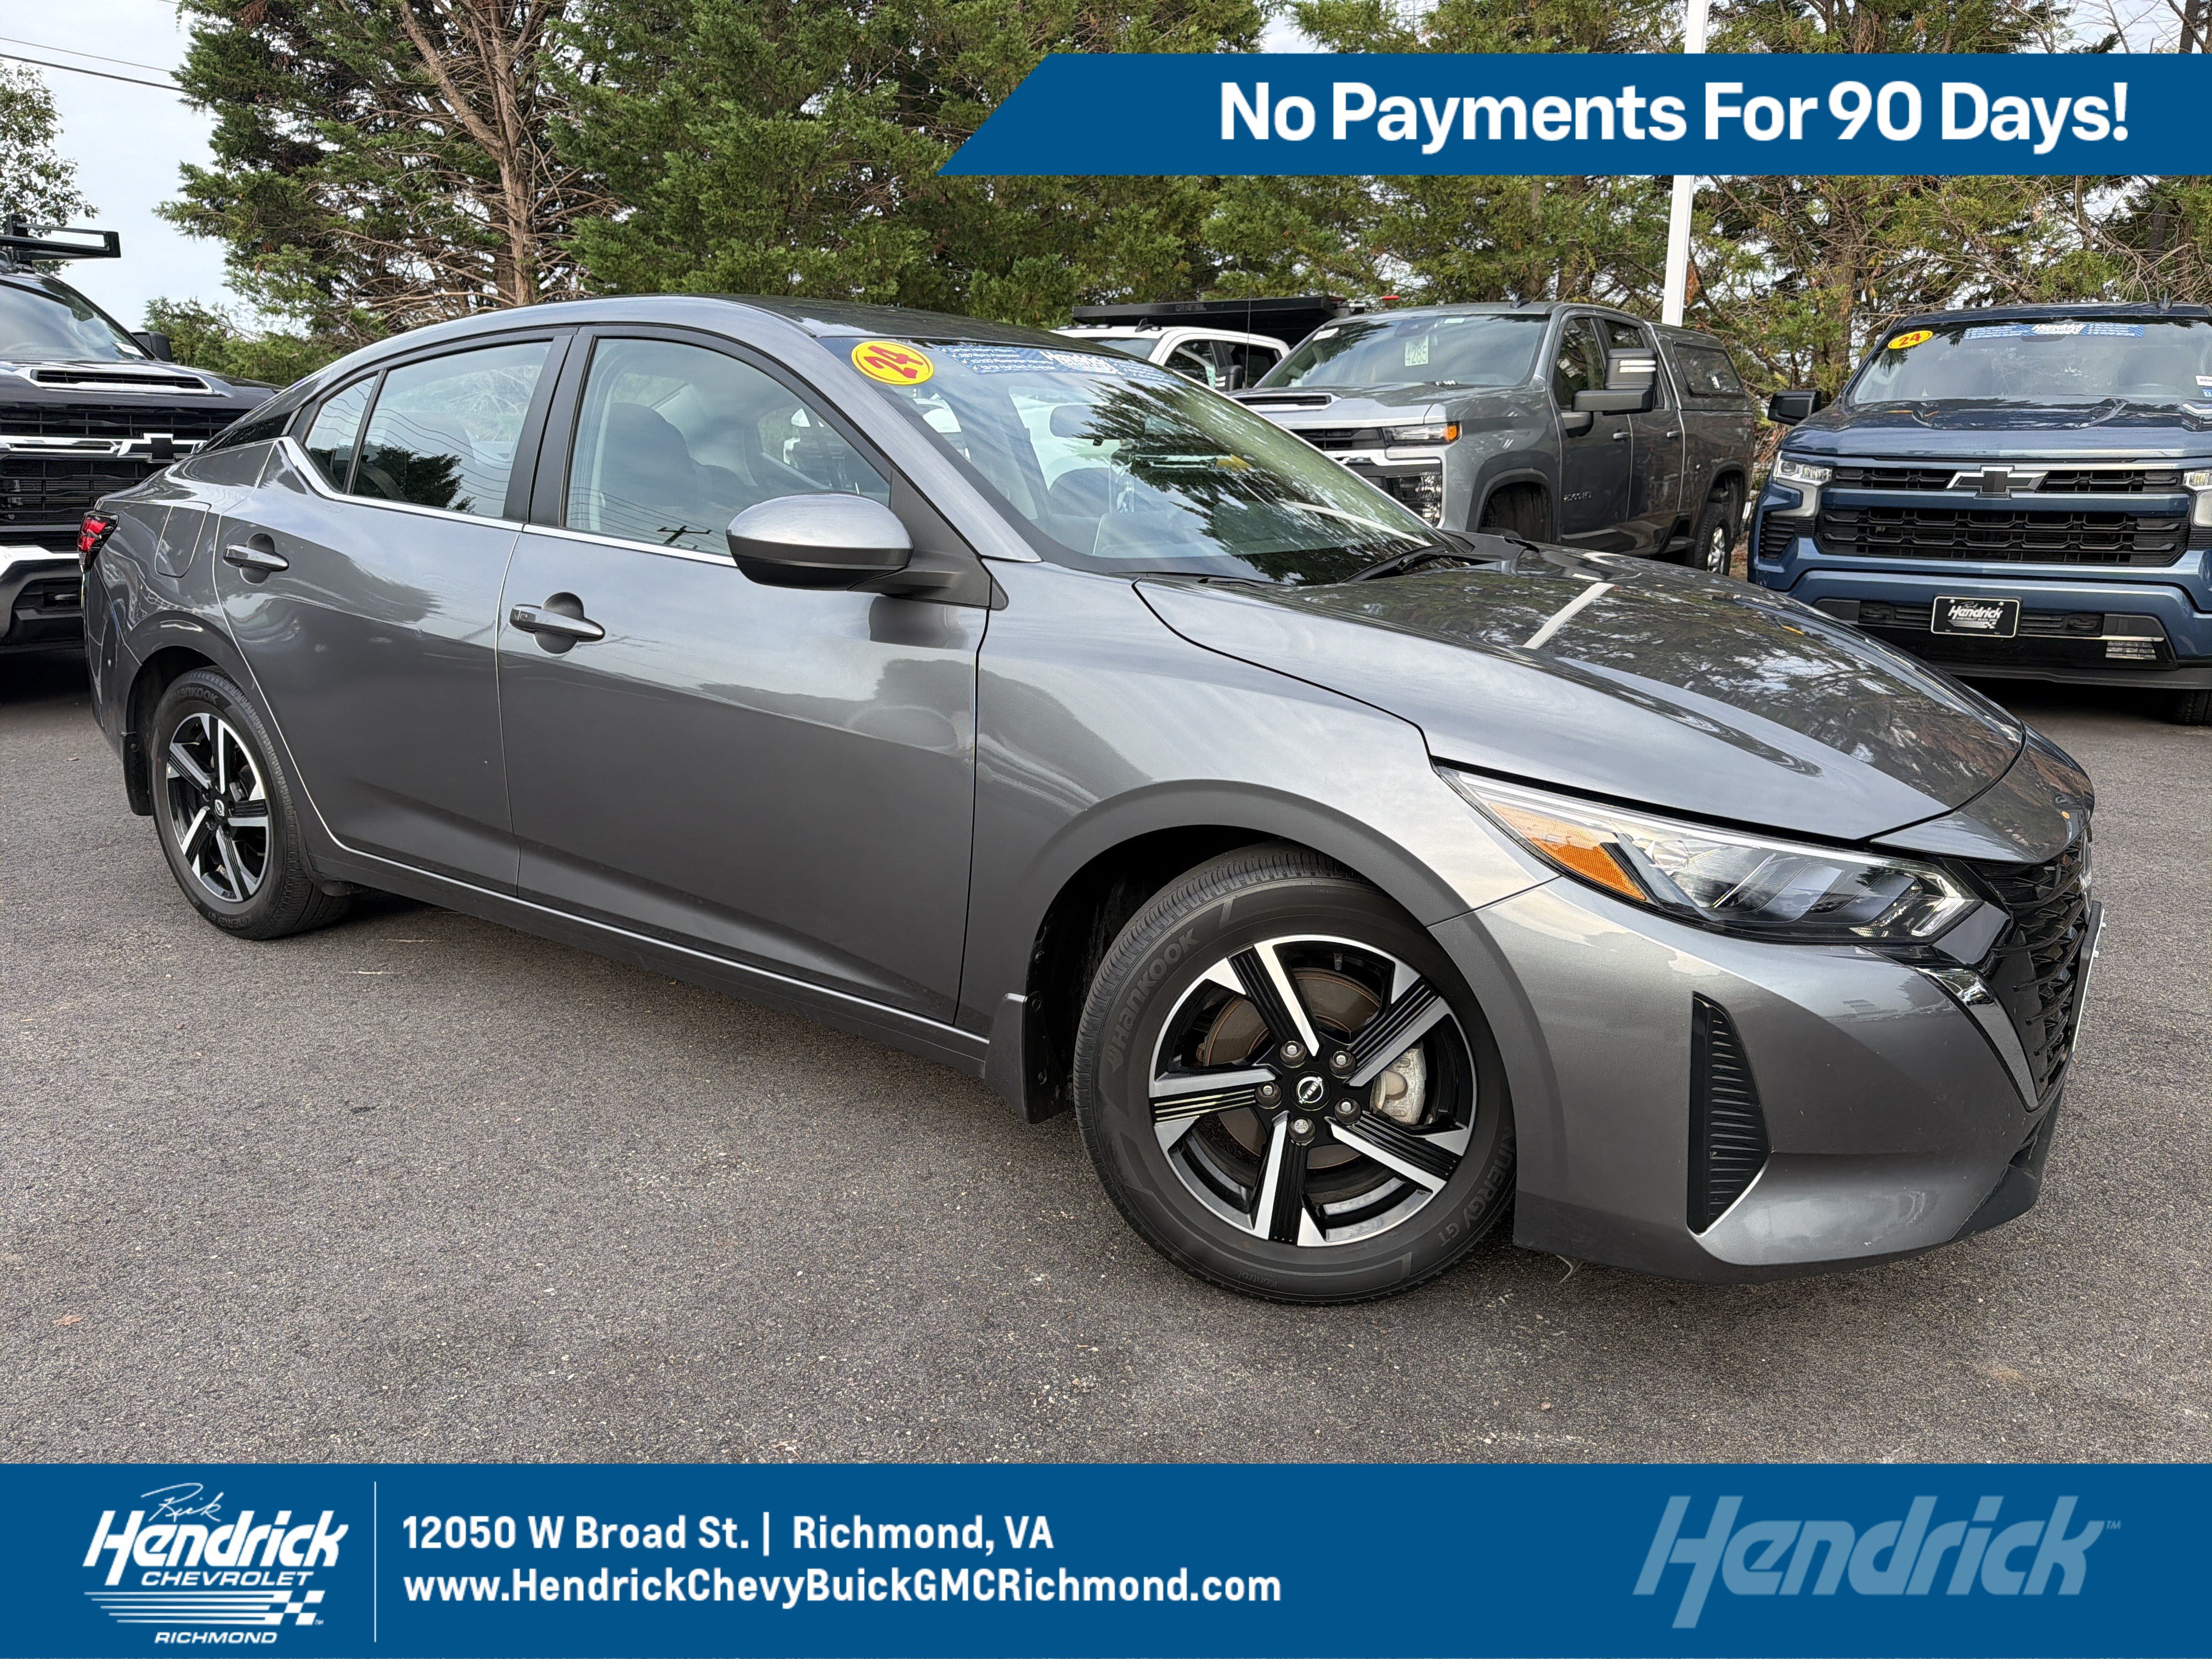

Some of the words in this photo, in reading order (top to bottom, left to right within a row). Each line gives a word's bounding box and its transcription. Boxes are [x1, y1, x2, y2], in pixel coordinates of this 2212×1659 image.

[1898, 332, 1921, 347] 24
[863, 345, 924, 379] 24
[1947, 605, 2004, 620] Hendrick
